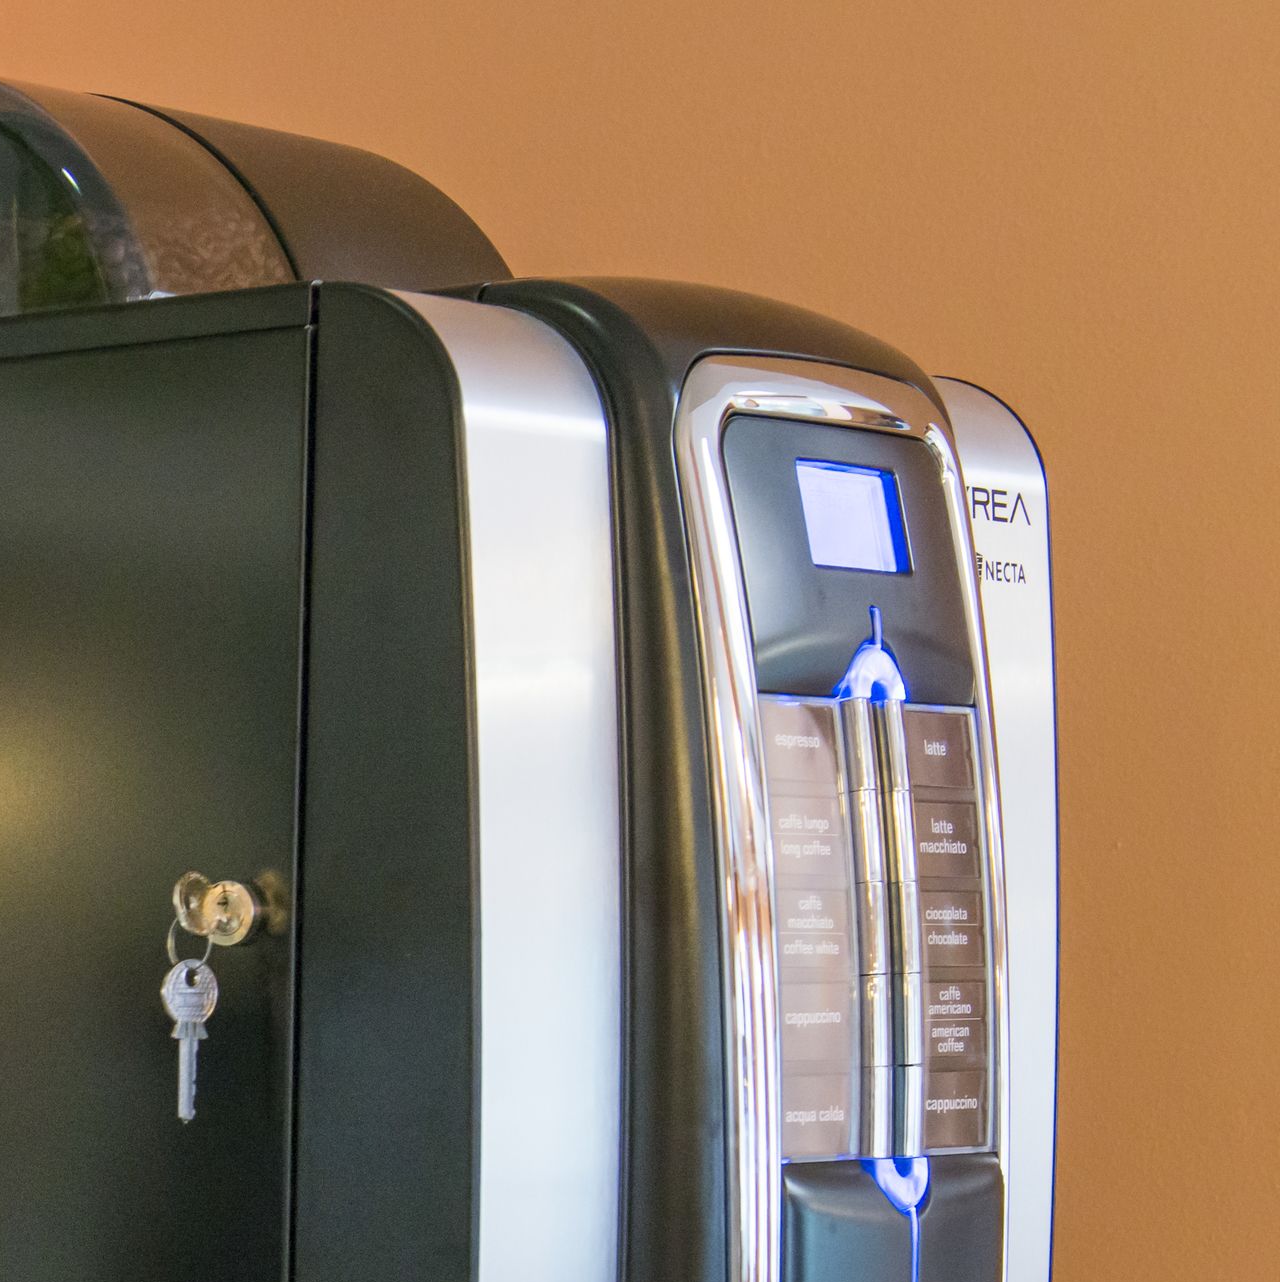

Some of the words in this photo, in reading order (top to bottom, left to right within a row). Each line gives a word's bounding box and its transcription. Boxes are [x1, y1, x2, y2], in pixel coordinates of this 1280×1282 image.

[966, 486, 1031, 526] REA
[985, 560, 1026, 584] NECTA
[924, 740, 947, 756] latte
[931, 818, 953, 834] latte
[920, 839, 967, 854] macchiato
[926, 907, 968, 920] cioccolata
[928, 931, 968, 945] chocolate
[939, 986, 961, 1000] caffè
[928, 1002, 972, 1015] americano
[785, 1009, 841, 1028] cappuccino
[932, 1025, 969, 1038] american
[937, 1038, 964, 1053] coffee
[926, 1095, 978, 1114] cappuccino
[786, 1110, 817, 1126] acqua
[819, 1105, 844, 1121] calda
